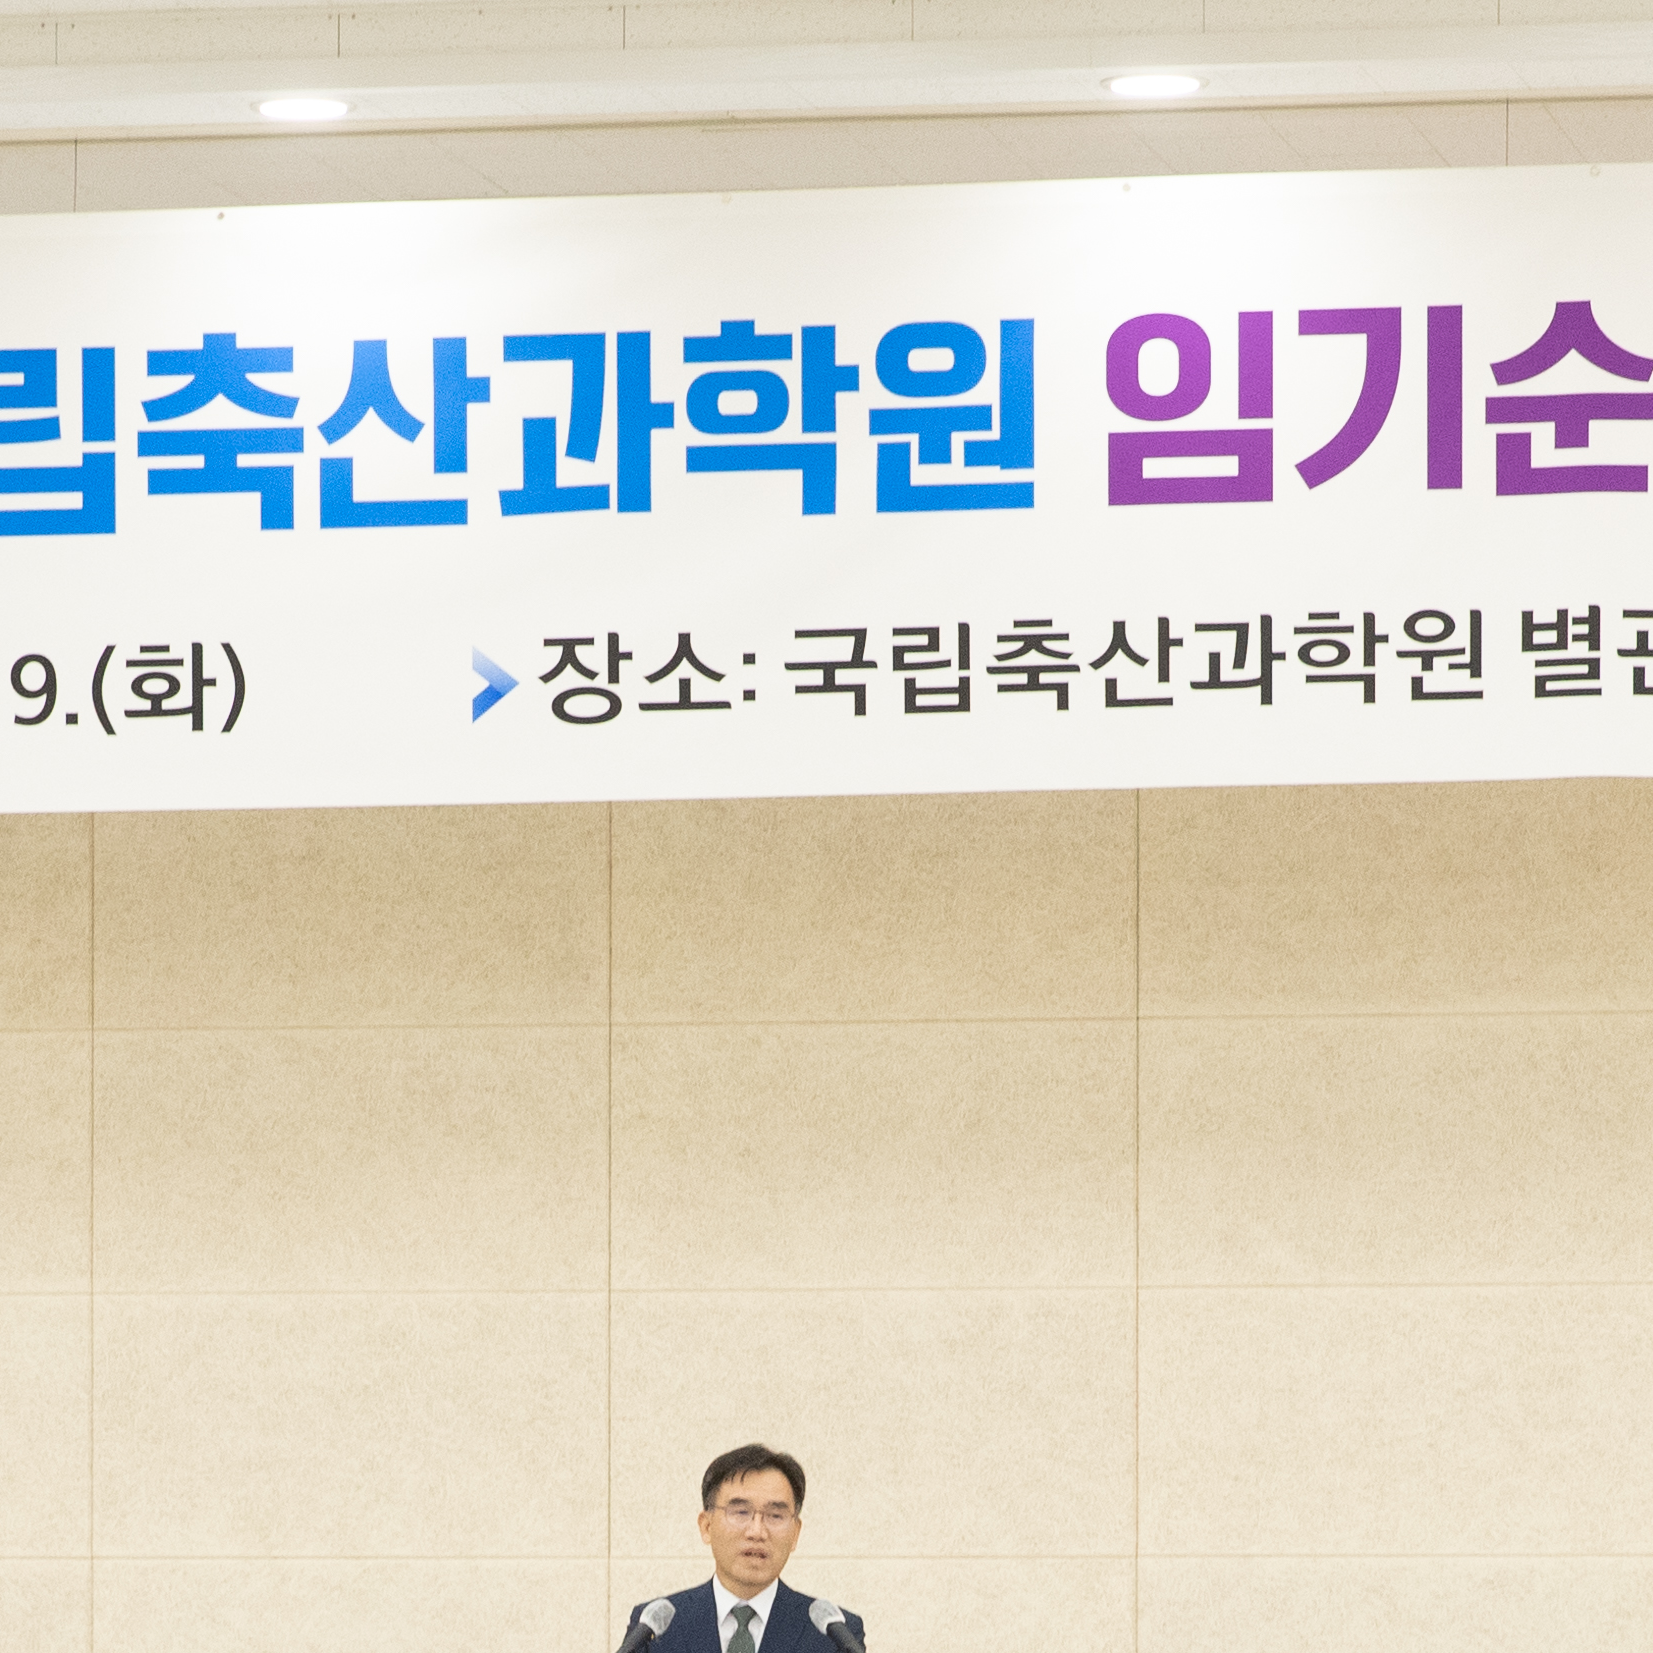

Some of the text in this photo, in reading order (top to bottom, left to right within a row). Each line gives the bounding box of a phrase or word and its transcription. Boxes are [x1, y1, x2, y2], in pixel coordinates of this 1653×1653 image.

[11, 642, 245, 735] 9.(화)
[539, 632, 755, 725] 장소:
[785, 610, 1483, 716] 국립축산과학원
